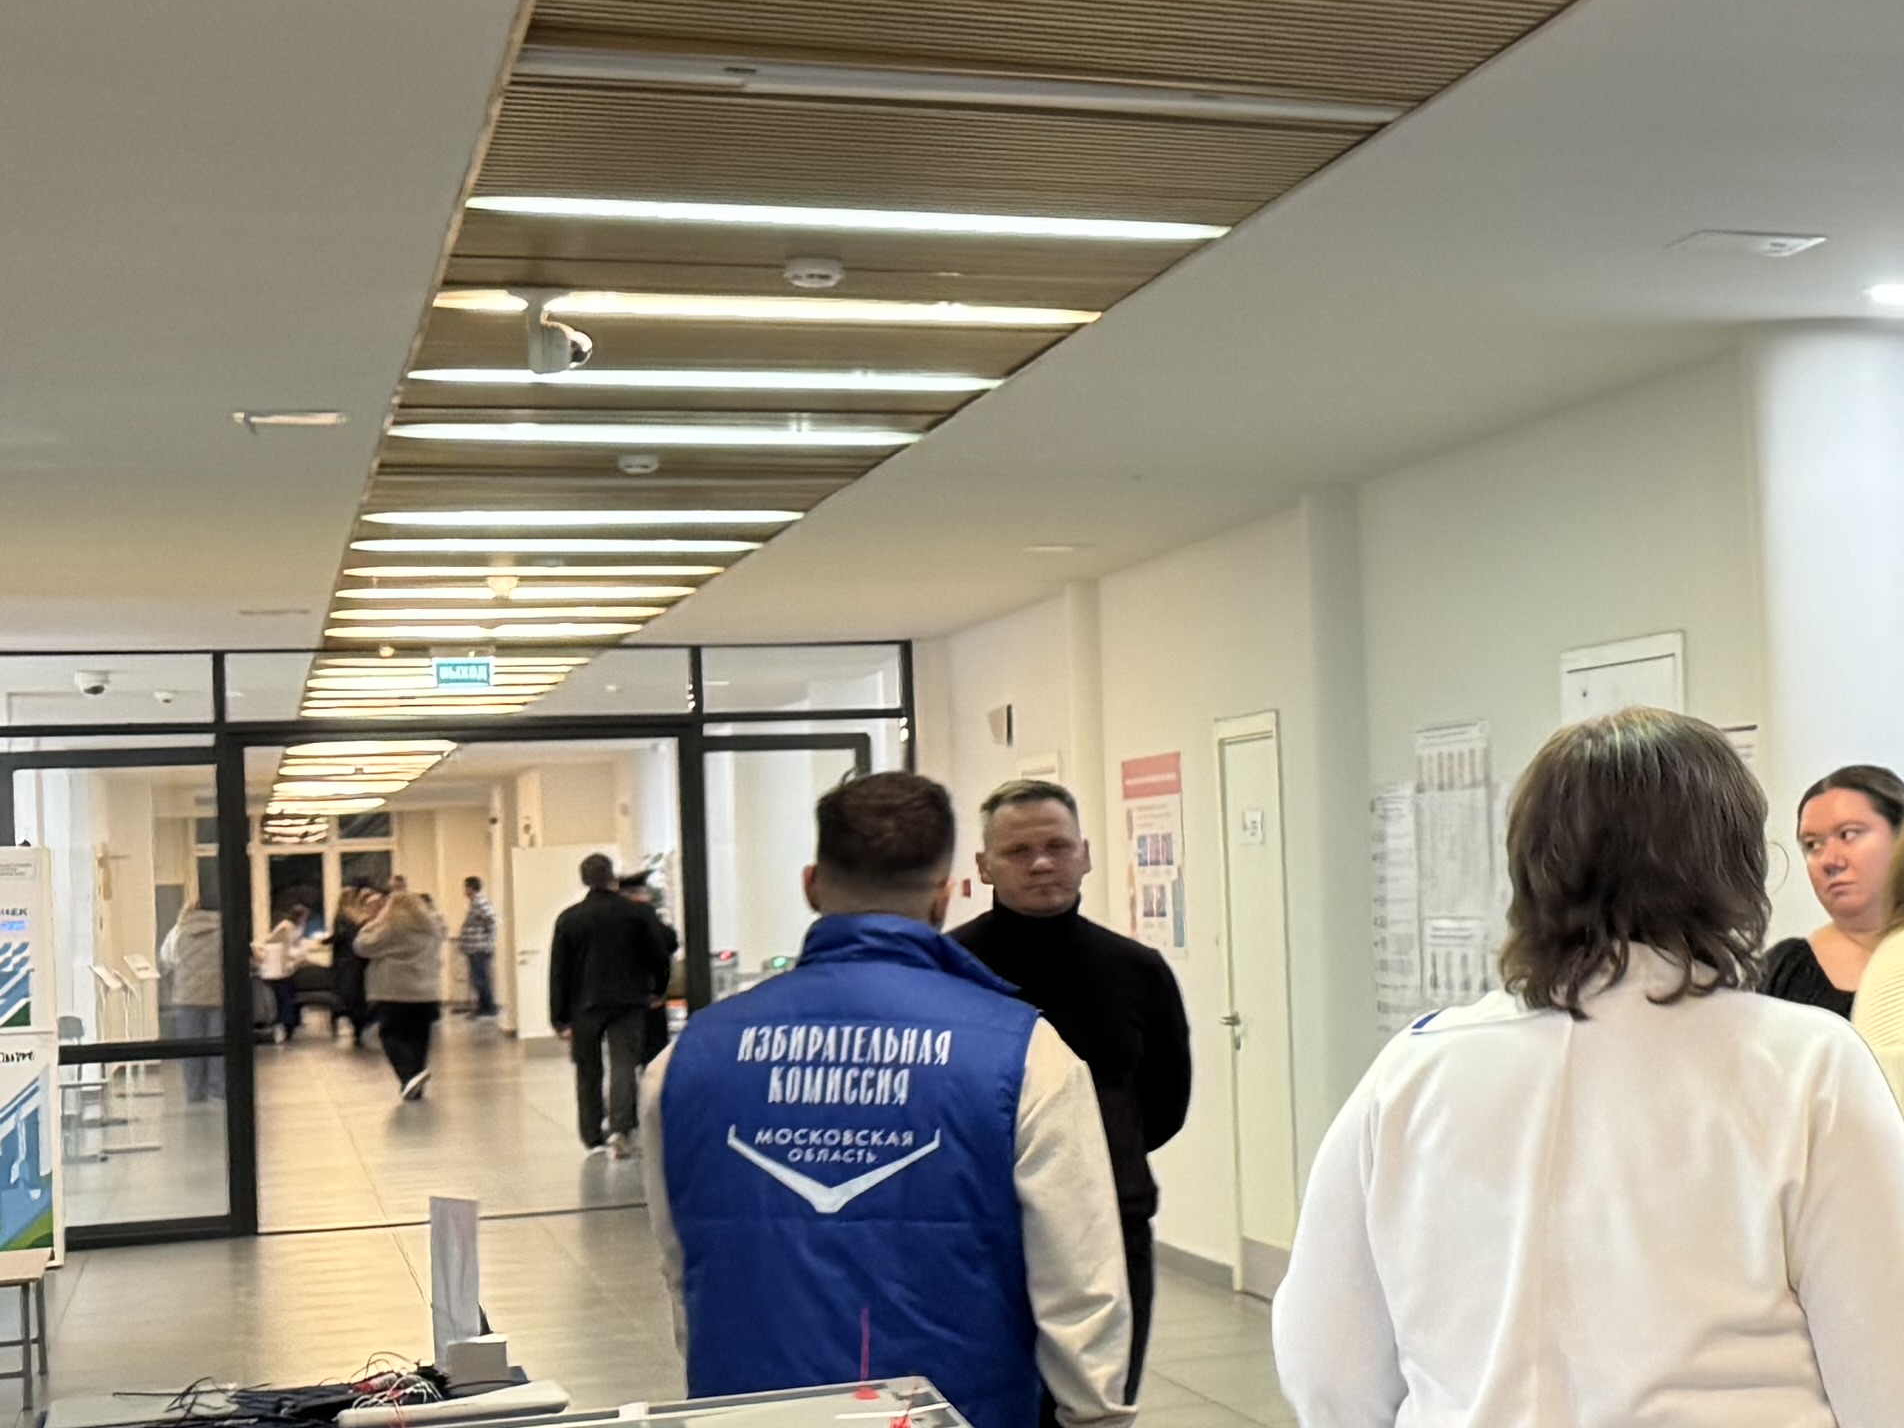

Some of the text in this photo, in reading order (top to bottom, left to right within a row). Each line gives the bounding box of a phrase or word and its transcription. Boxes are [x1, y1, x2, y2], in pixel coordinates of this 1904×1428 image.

[738, 1026, 952, 1065] ИЗБИРАТЕЛЬНАЯ
[769, 1066, 910, 1105] КОМИССИЯ
[756, 1129, 914, 1147] МОСКОВСКАЯ
[787, 1146, 877, 1164] ОБЛАСТЬ
